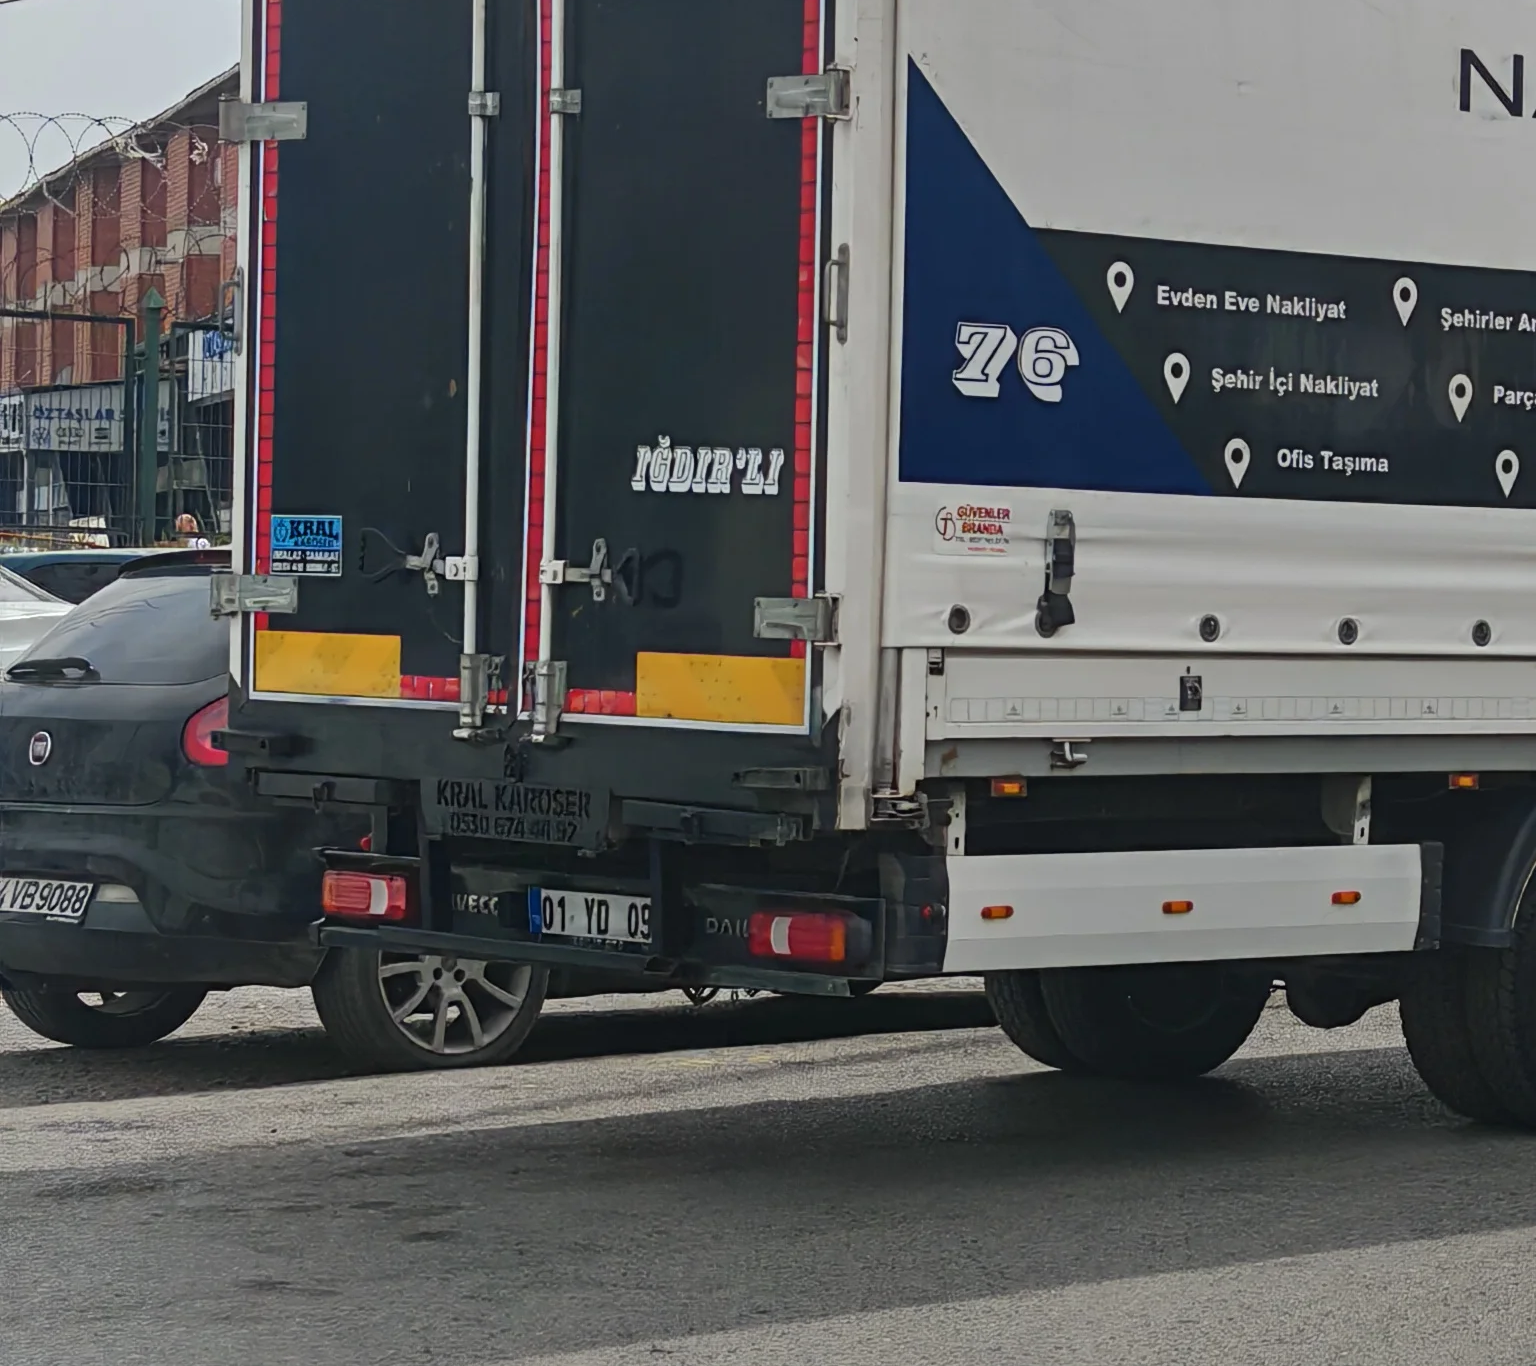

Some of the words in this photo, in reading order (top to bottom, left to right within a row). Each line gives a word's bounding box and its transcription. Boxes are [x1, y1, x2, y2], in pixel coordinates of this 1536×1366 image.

[1156, 285, 1218, 310] Evden
[1224, 291, 1260, 313] Eve
[1266, 294, 1347, 322] Nakliyat
[1440, 307, 1513, 332] Şehirler
[952, 321, 1080, 403] 76
[1211, 367, 1263, 393] Şehir
[1269, 367, 1293, 396] İçi
[1300, 373, 1379, 401] Nakliyat
[1277, 448, 1314, 469] Ofis
[1320, 451, 1389, 476] Taşıma
[956, 504, 1011, 520] GÜVENLER
[289, 519, 340, 540] KRAL
[961, 521, 1004, 536] BRANDA
[436, 779, 488, 810] KRAL
[542, 894, 566, 932] 01
[584, 896, 609, 935] YD
[706, 916, 750, 937] DAIL
